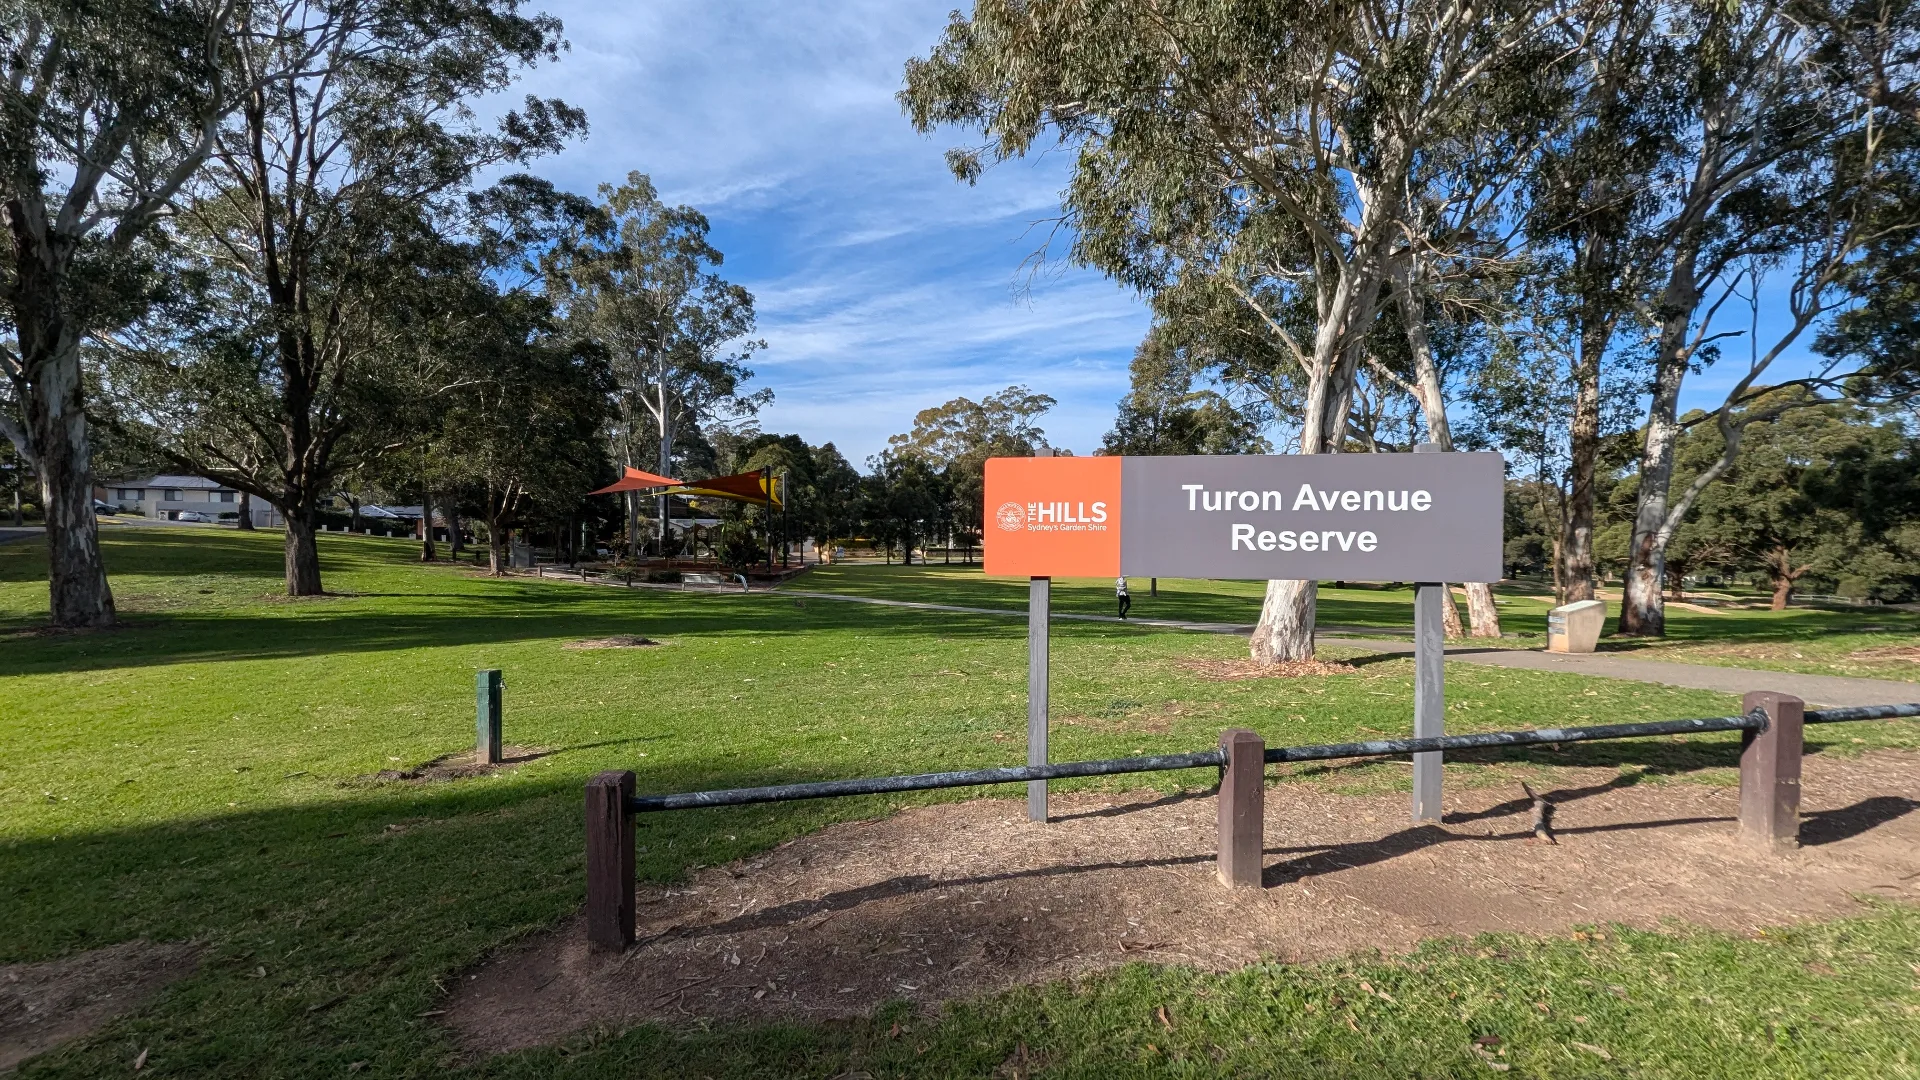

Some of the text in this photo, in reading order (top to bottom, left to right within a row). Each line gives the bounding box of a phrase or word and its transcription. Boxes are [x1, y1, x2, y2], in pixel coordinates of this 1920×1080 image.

[1181, 484, 1432, 512] Turon Avenue
[1028, 502, 1037, 522] THE
[1038, 502, 1107, 523] HILLS
[1027, 523, 1107, 533] Sydney's Garden Shire
[1231, 524, 1378, 552] Reserve
